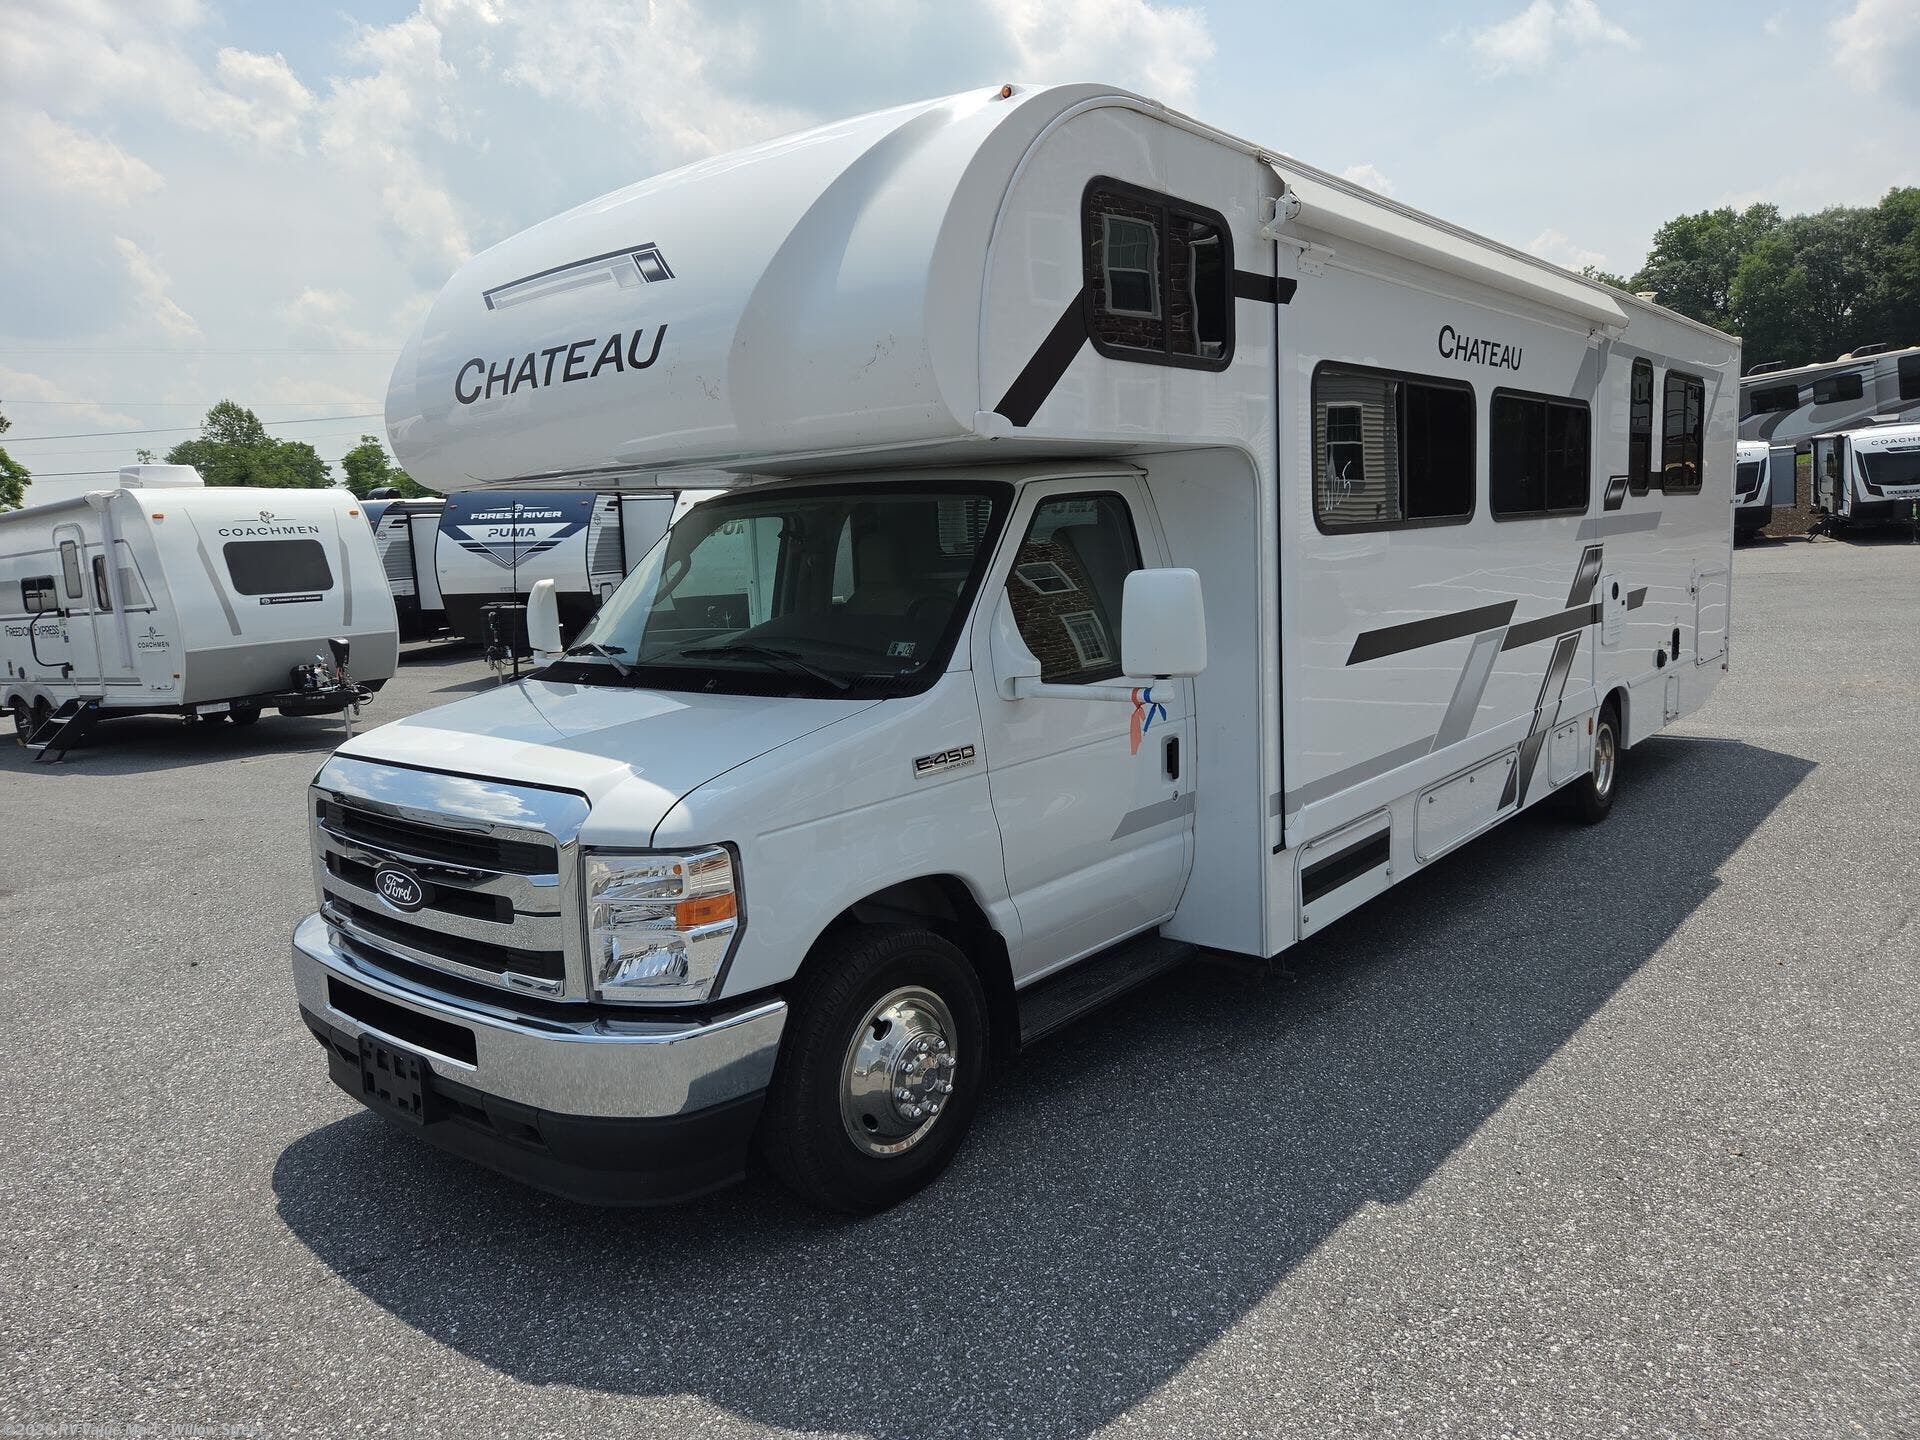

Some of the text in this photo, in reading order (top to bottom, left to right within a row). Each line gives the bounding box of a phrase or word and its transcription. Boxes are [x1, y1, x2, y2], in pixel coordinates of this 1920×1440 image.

[1438, 324, 1523, 371] CHATEAU
[454, 324, 668, 405] CHATEAU
[1870, 437, 1920, 446] COACH
[470, 511, 562, 520] FOREST RIVER
[218, 525, 319, 537] COACHMEN
[488, 528, 536, 538] PUMA
[137, 641, 170, 649] COACHMEN
[384, 873, 412, 901] Ford
